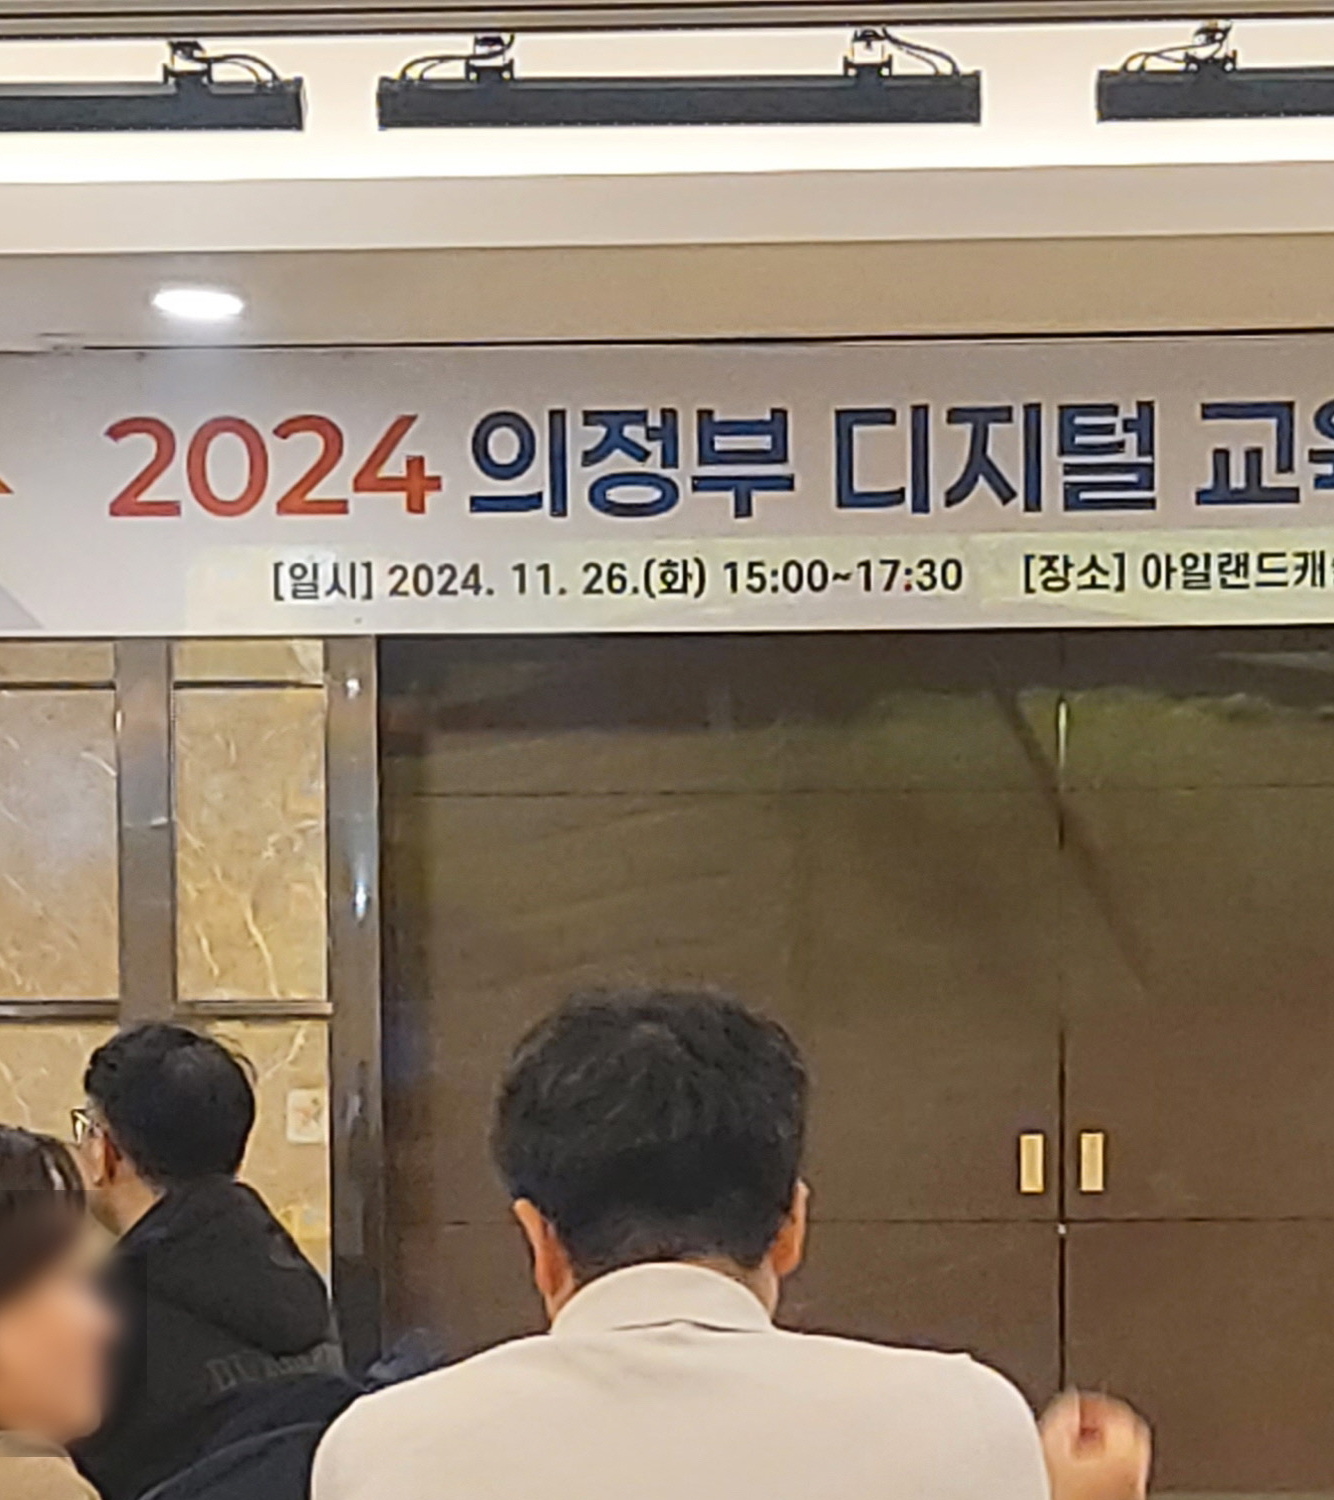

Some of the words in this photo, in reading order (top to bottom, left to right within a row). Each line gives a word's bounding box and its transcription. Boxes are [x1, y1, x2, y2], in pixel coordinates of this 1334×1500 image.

[105, 415, 442, 517] 2024
[469, 408, 795, 519] 의정부
[835, 400, 1156, 514] 디지털
[273, 560, 373, 602] [일시]
[387, 562, 495, 598] 2024.
[511, 562, 568, 596] 11.
[582, 556, 706, 600] 26.(화)
[723, 557, 963, 595] 15:00~17:30
[1023, 552, 1126, 595] [장소]
